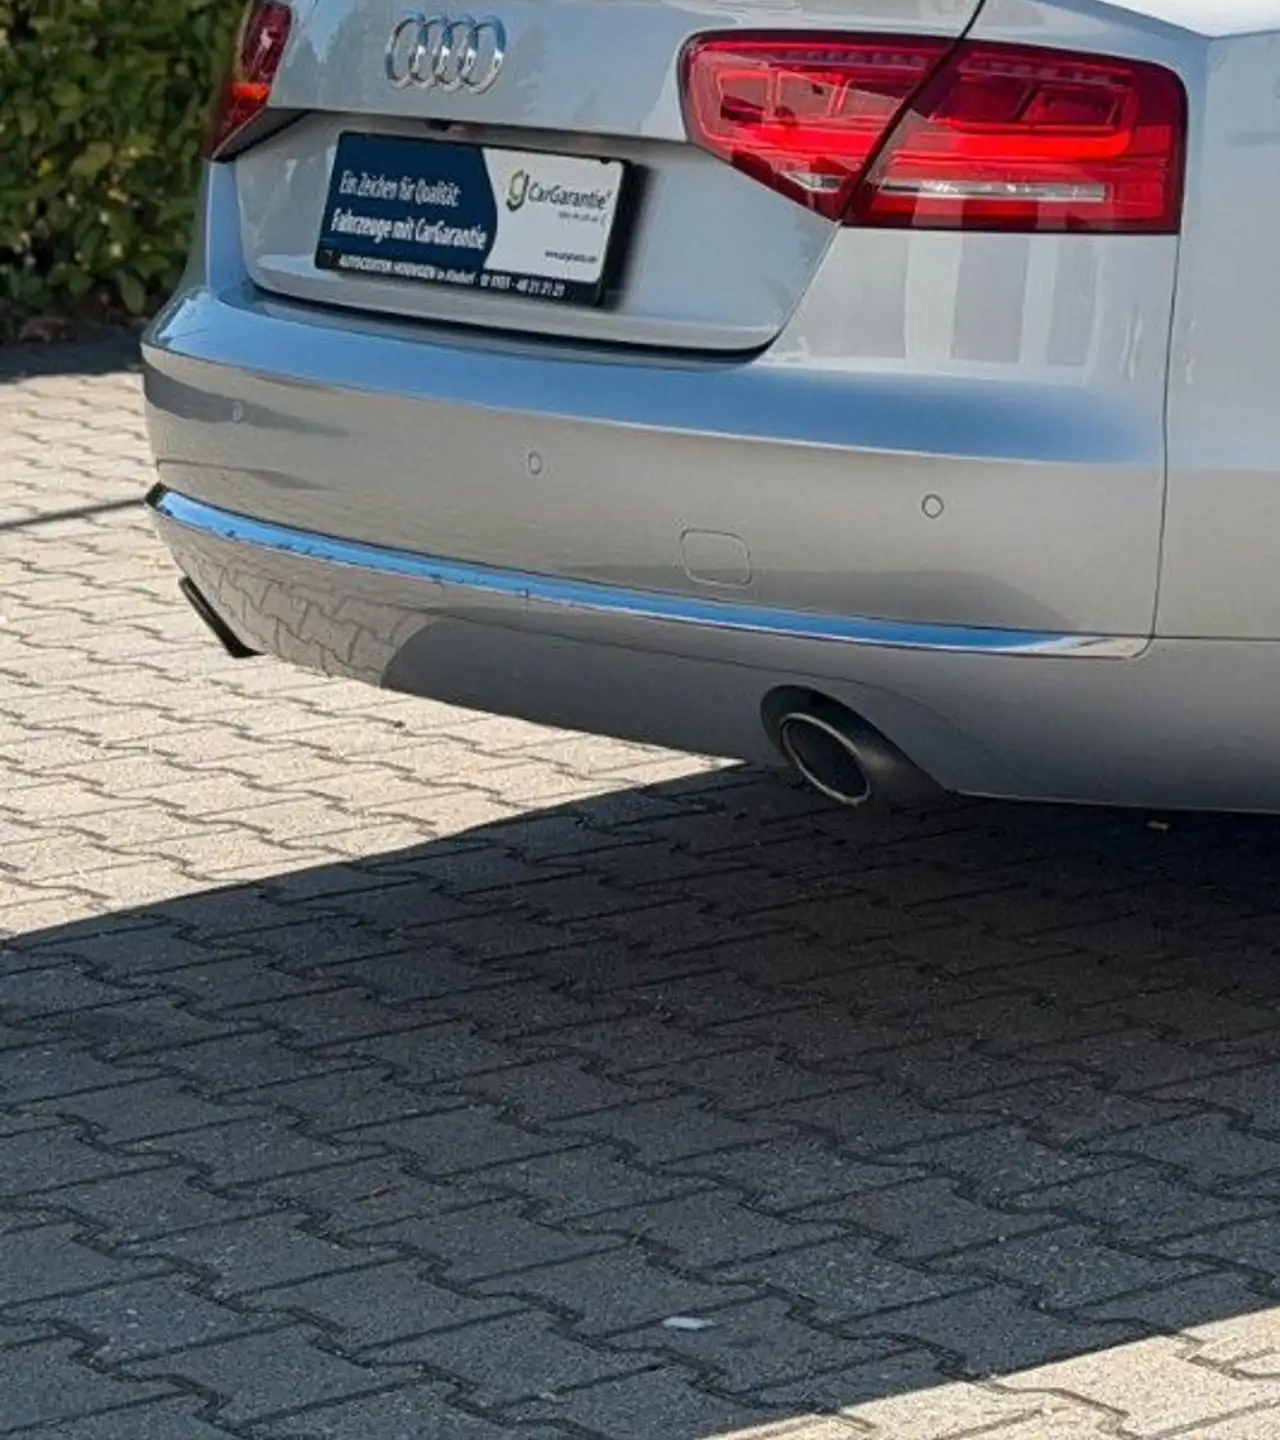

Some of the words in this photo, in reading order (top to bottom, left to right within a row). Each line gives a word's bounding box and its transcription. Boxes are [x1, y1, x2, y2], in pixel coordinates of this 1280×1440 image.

[339, 171, 359, 194] Ein
[358, 173, 398, 200] Zeichen
[399, 175, 416, 201] für
[331, 208, 392, 244] Fahrzeuge
[392, 216, 415, 241] mit
[415, 218, 488, 250] CarGarantie
